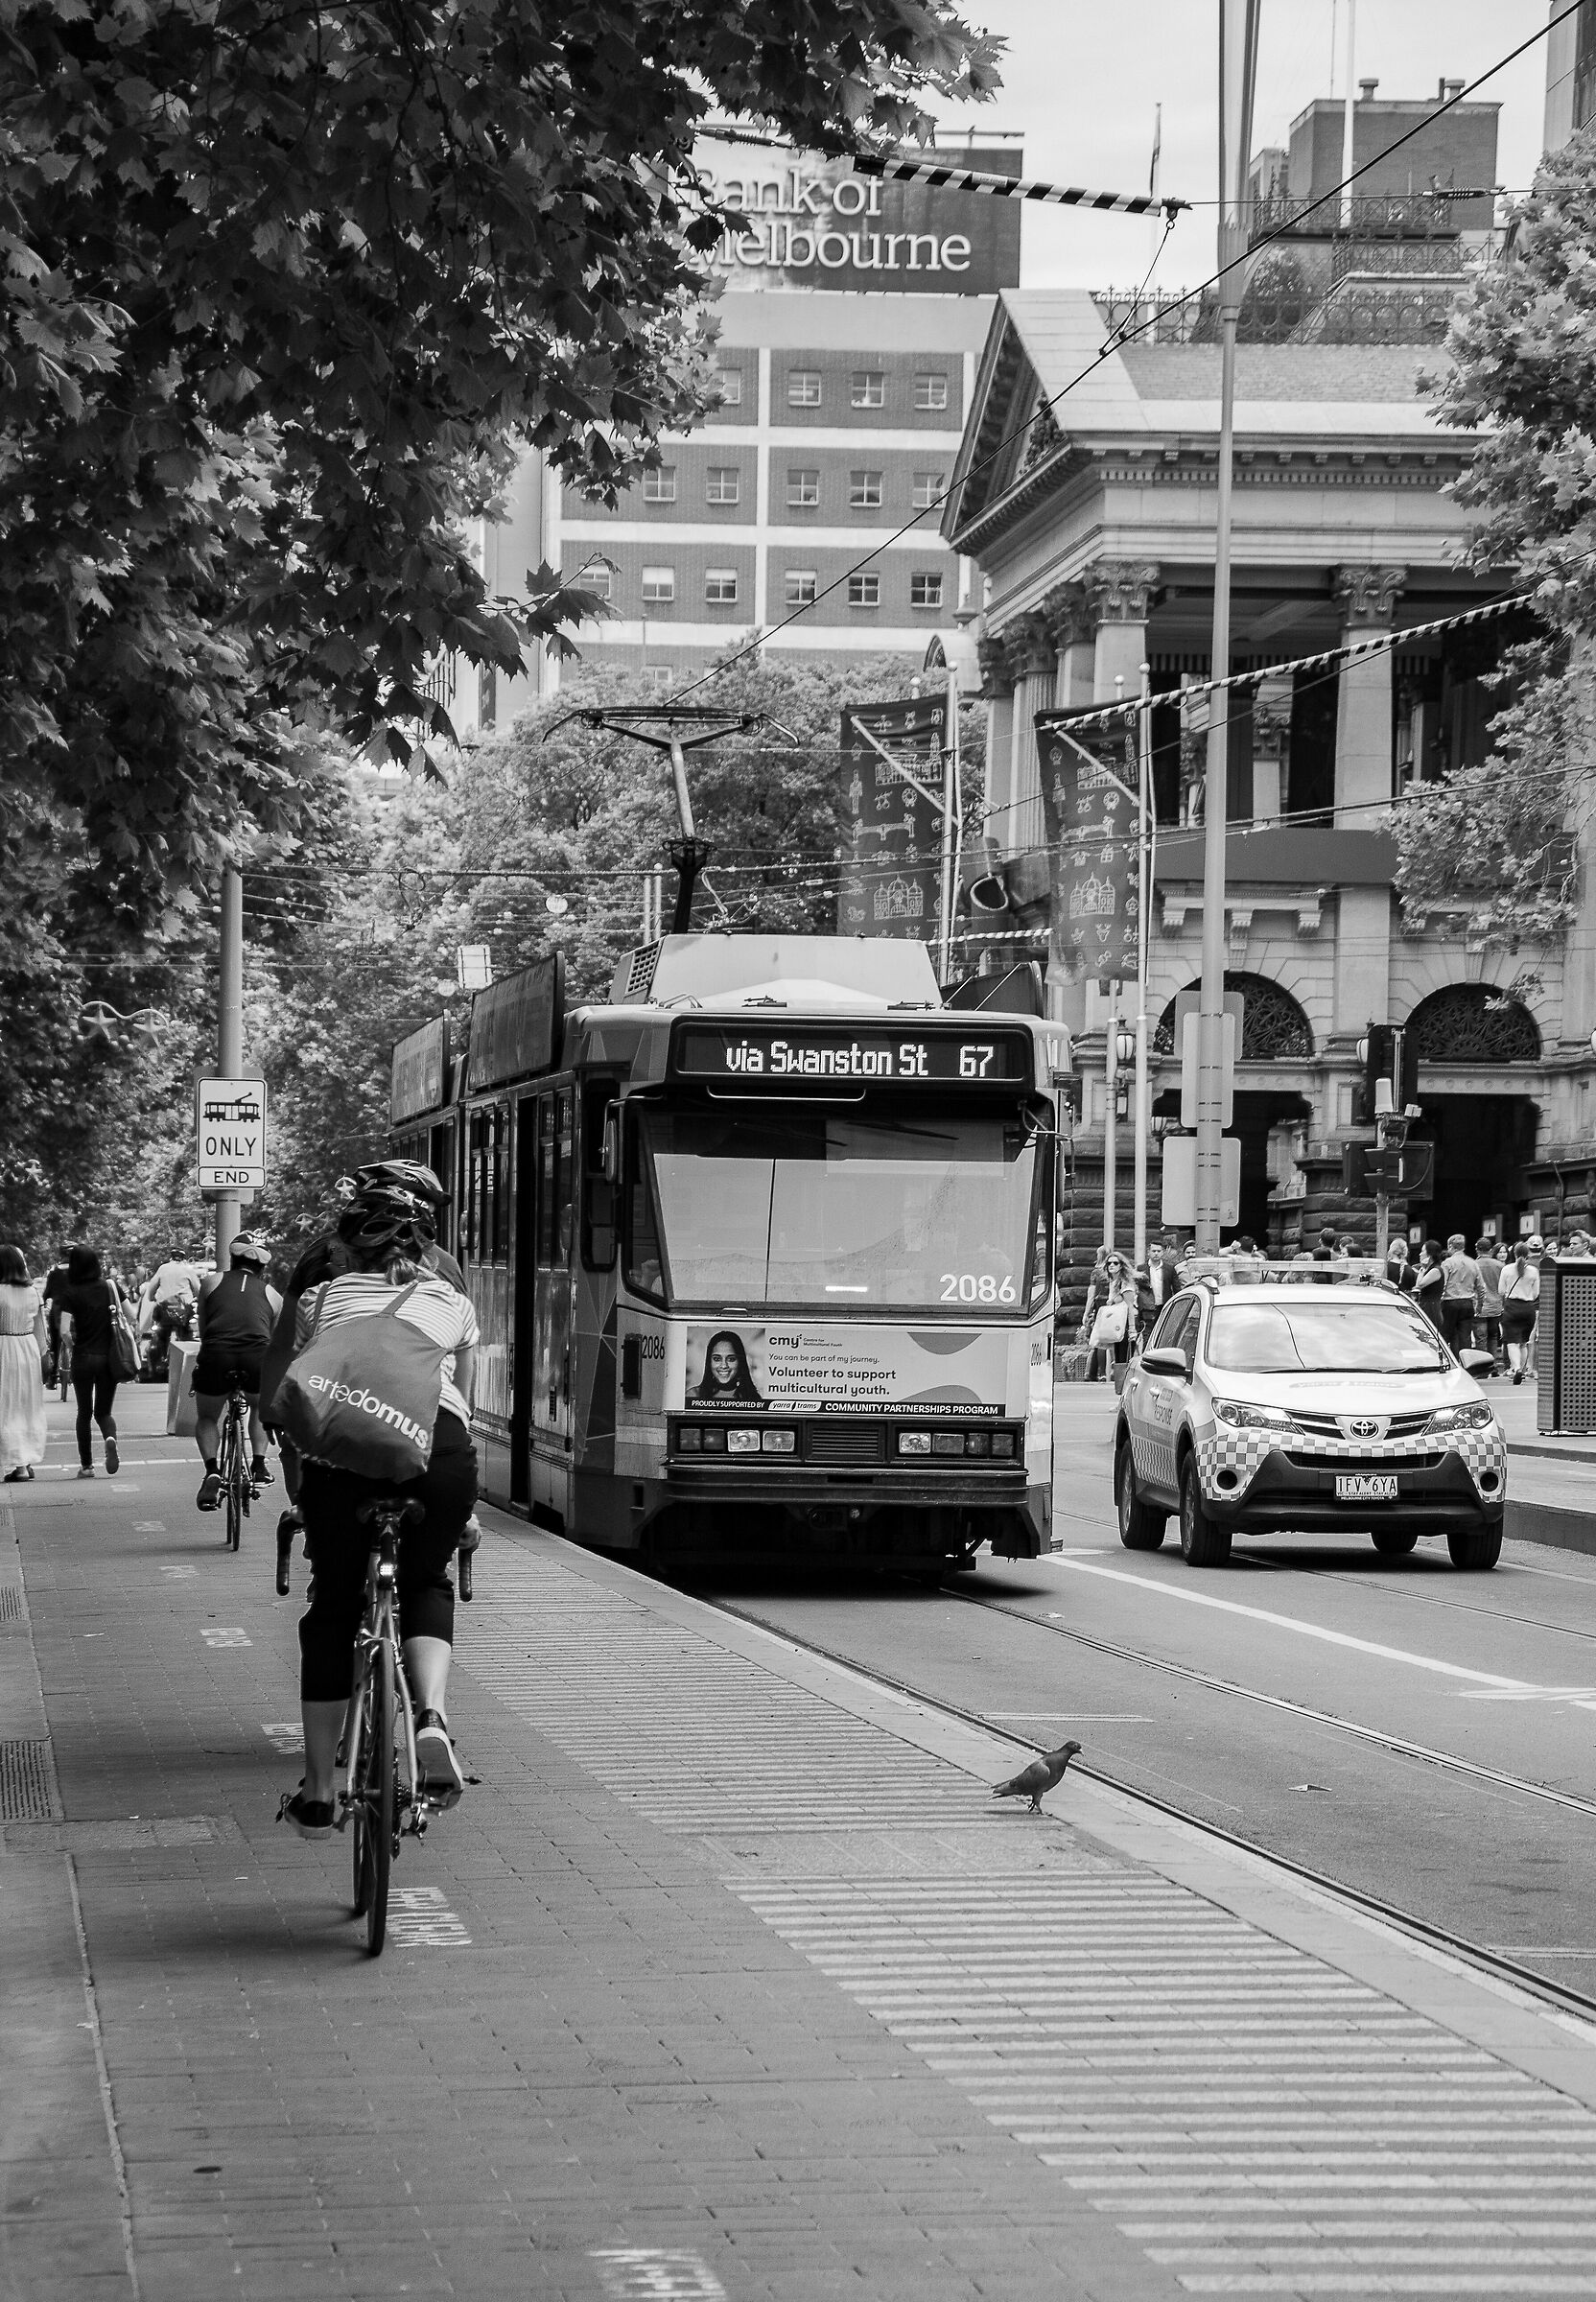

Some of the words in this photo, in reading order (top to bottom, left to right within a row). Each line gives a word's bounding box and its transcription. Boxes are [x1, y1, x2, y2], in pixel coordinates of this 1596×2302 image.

[833, 172, 884, 217] of
[726, 1041, 763, 1071] via
[770, 1042, 892, 1075] Swanston
[899, 1044, 928, 1076] St
[959, 1045, 994, 1077] 67
[205, 1137, 256, 1156] ONLY
[214, 1171, 249, 1183] END
[939, 1274, 1016, 1303] 2086
[642, 1335, 665, 1359] 2086
[768, 1336, 799, 1349] cmy
[810, 1355, 826, 1365] part
[849, 1355, 880, 1364] journey.
[768, 1366, 829, 1377] Volunteer
[832, 1368, 844, 1378] to
[847, 1370, 896, 1381] support
[768, 1382, 847, 1394] multicultural
[851, 1385, 890, 1397] youth.
[308, 1374, 429, 1449] artedomus
[772, 1401, 791, 1410] yarra
[825, 1402, 882, 1412] COMMUNITY
[883, 1404, 951, 1414] PARTNERSHIPS
[952, 1405, 998, 1415] PROGRAM
